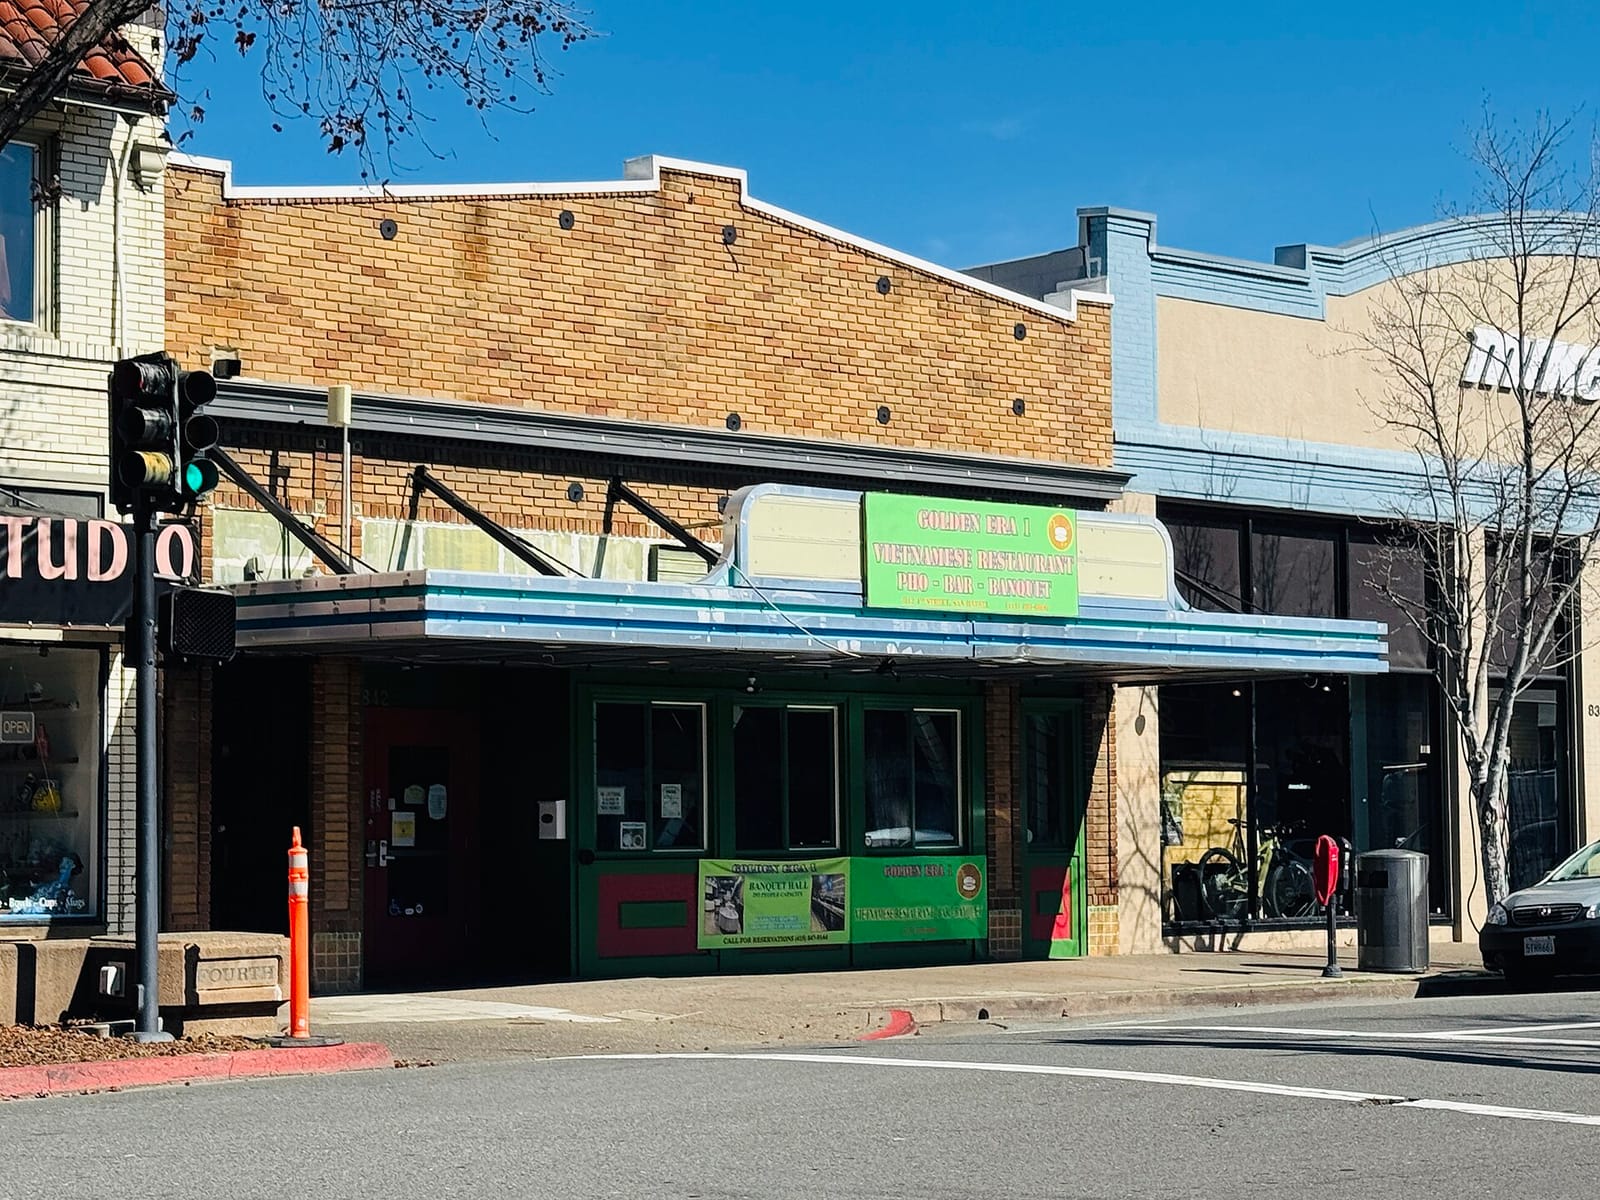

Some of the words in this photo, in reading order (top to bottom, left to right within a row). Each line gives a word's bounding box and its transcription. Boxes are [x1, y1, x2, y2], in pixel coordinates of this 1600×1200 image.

[917, 508, 980, 533] GOLDEN
[985, 514, 1018, 536] ERA
[872, 542, 972, 569] VIETNAMESE
[977, 549, 1074, 575] RESTAURANT
[897, 571, 929, 592] PHO
[943, 574, 974, 595] BAR
[988, 577, 1052, 599] BANQUET
[3, 720, 31, 734] OPEN
[749, 881, 787, 891] BANQUET
[788, 880, 809, 890] HALL
[723, 937, 739, 945] CALL
[739, 936, 752, 944] FOR
[752, 935, 794, 944] RESERVATIONS
[198, 965, 275, 983] FOURTH
